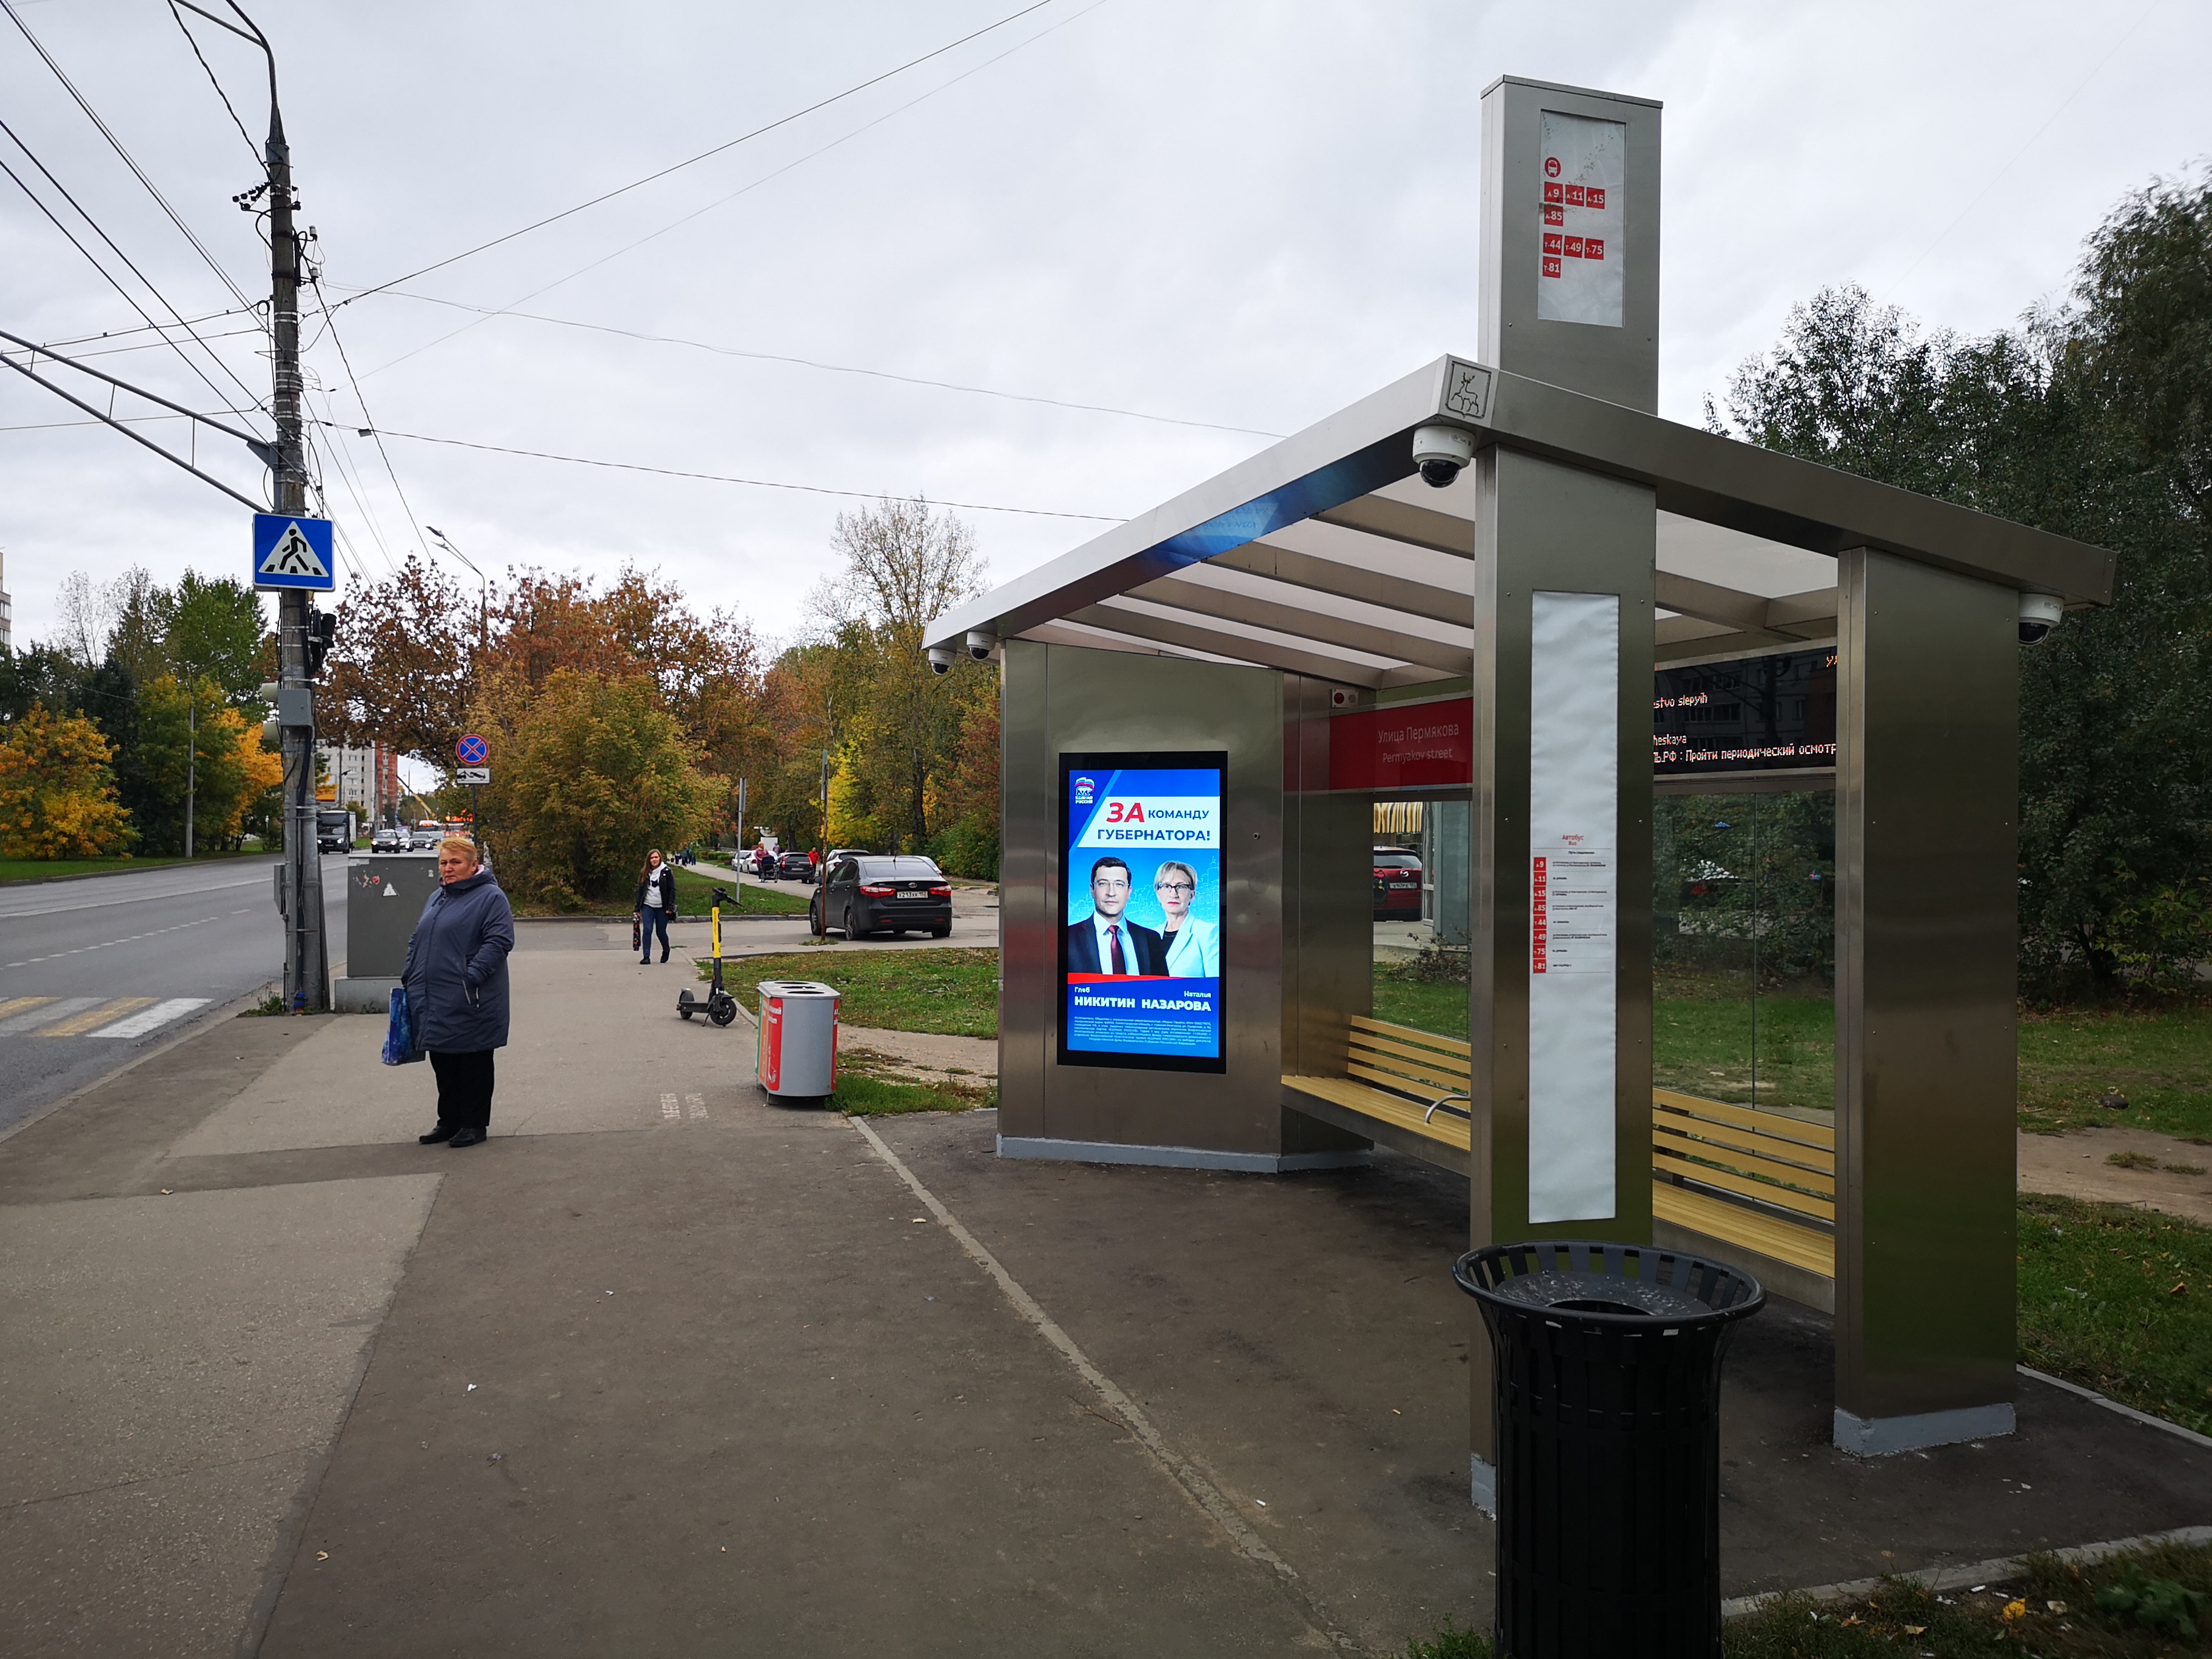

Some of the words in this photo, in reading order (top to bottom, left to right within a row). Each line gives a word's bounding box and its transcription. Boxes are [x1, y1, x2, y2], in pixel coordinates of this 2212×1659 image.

[1378, 730, 1404, 745] Улица
[1407, 724, 1459, 742] Пермякова
[1654, 734, 1687, 746] heskaya
[1383, 749, 1425, 764] Permyakov
[1427, 747, 1453, 759] street
[1686, 749, 1718, 763] Пройти
[1721, 743, 1795, 760] периодический
[1106, 802, 1145, 823] ЗА
[1148, 810, 1209, 820] КОМАНДУ
[1098, 830, 1210, 841] ГУБЕРНАТОРА!
[1074, 996, 1135, 1008] НИКИТИН
[1142, 999, 1212, 1011] НАЗАРОВА
